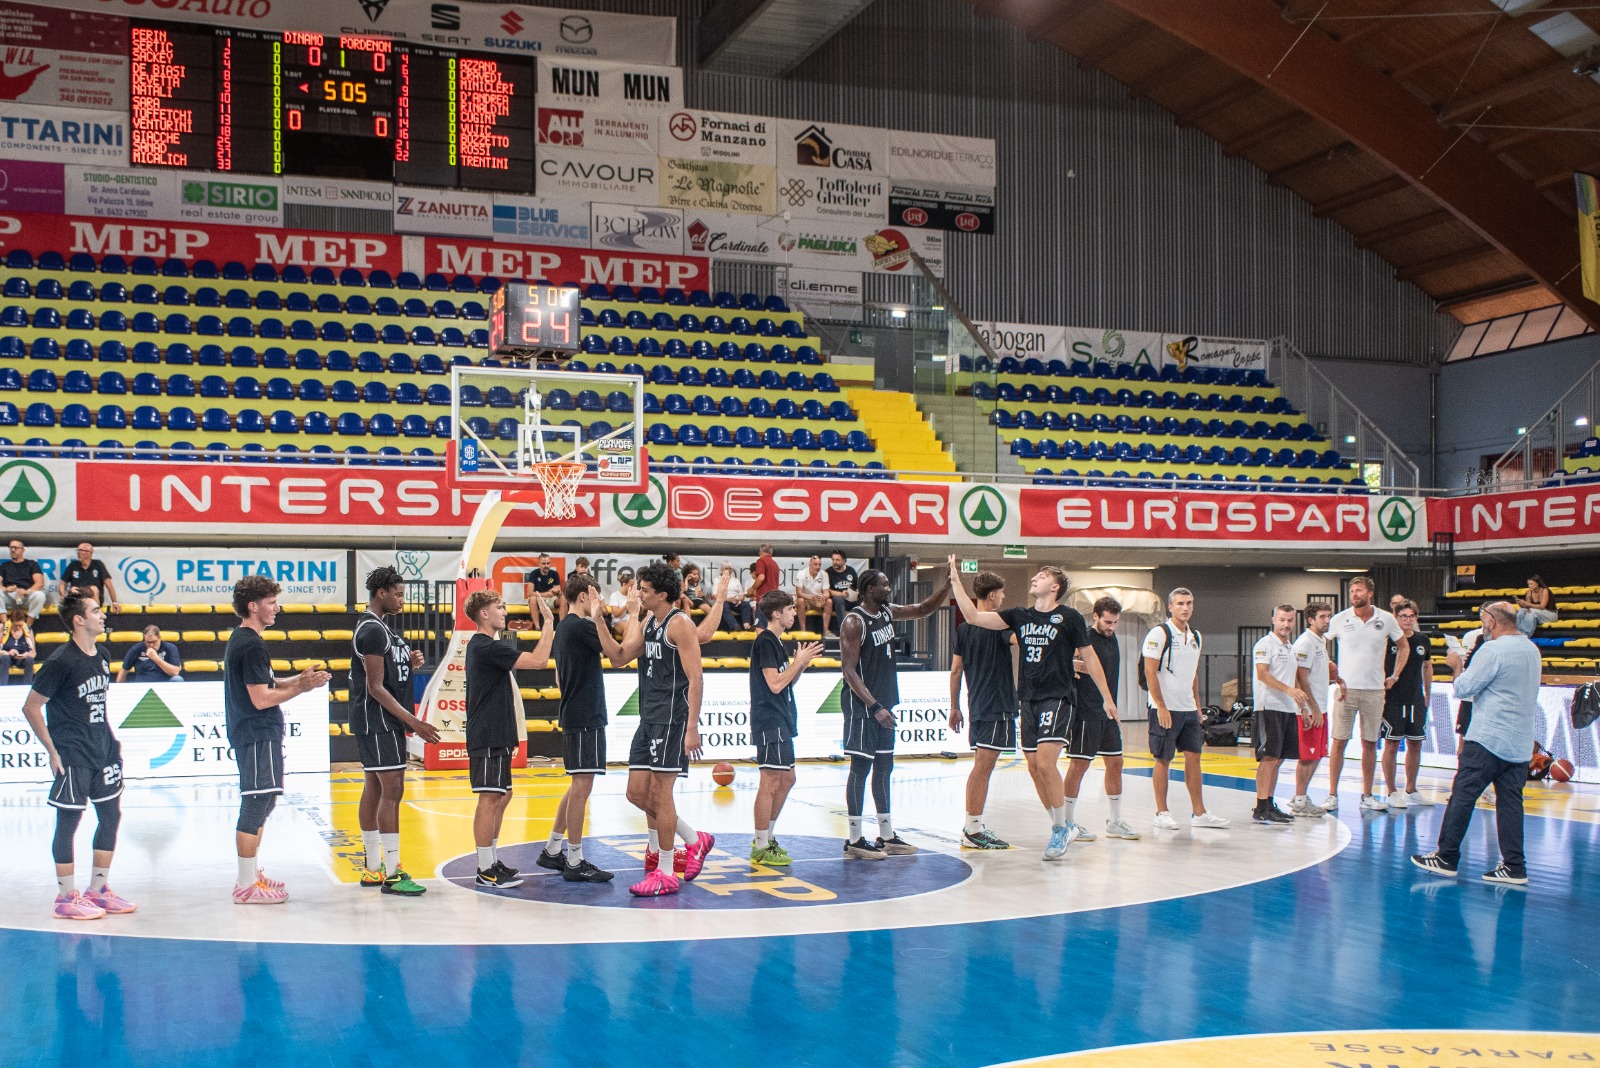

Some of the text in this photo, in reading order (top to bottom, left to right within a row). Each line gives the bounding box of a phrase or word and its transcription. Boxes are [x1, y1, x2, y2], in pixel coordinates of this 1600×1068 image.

[132, 28, 167, 42] PERIN
[215, 29, 231, 37] PLYR
[237, 31, 257, 39] FOULS
[283, 31, 392, 53] DINAMO PORDENON
[421, 34, 471, 46] SEAT
[484, 37, 542, 51] SUZUKI
[132, 39, 173, 53] SERTIC
[415, 48, 434, 56] FOULS
[132, 51, 173, 64] SACKEY
[308, 46, 386, 73] 0 0
[401, 54, 497, 72] 4 AZZANO
[132, 63, 186, 78] DE BIASI
[328, 69, 351, 77] PERIOD
[401, 64, 501, 83] 6 CRAVEDI
[132, 74, 180, 88] DEVETTA
[402, 75, 514, 95] 7 MINICLERI
[552, 67, 670, 102] MUN MUN
[132, 84, 231, 104] NATALI 10
[402, 85, 509, 104] 9 D'ANDREA
[132, 96, 231, 114] SARA 11
[285, 103, 305, 111] FOULS
[372, 110, 392, 118] FOULS
[398, 97, 509, 116] 10 RINALDIN
[133, 107, 231, 125] TOFFETCHI 13
[288, 110, 388, 137] 0 0
[398, 108, 496, 125] 11 CUGINI
[594, 118, 649, 131] SERRAMENTI
[701, 116, 766, 133] Fornaci di
[133, 118, 231, 136] VENTURINI 18
[398, 118, 492, 135] 14 VUJIC
[605, 129, 649, 140] ALLUMINIO
[133, 130, 231, 147] GIACCHE 25
[398, 128, 510, 148] 16 BOZZETTO
[701, 130, 766, 147] Manzano
[71, 147, 97, 155] SINCE
[133, 142, 231, 159] SANAD 27
[395, 139, 490, 156] 21 ROSSI
[133, 152, 231, 170] MICALICH 33
[395, 150, 508, 169] 22 TRENTINI
[540, 159, 654, 184] CAVOUR
[287, 185, 392, 201] INTESA SANPAOLO
[557, 180, 636, 192] IMMOBILIARE
[816, 176, 882, 196] Toffoletti
[210, 186, 274, 209] SIRIO
[181, 208, 278, 225] real estate group
[417, 201, 488, 218] ZANUTTA
[518, 206, 559, 224] BLUE
[852, 209, 862, 217] del
[864, 210, 885, 219] Lavoro
[518, 222, 589, 240] SERVICE
[708, 232, 770, 254] Cardinale
[69, 220, 699, 289] MEP MEP MEP MEP
[521, 307, 570, 344] 24
[462, 459, 477, 467] FIP
[610, 456, 632, 465] LNP
[671, 485, 944, 526] DESPAR
[1056, 497, 1367, 534] EUROSPAR
[176, 559, 337, 582] PETTARINI
[177, 585, 213, 593] ITALIAN
[287, 586, 314, 594] SINCE
[317, 586, 337, 594] 1957
[871, 623, 895, 647] DINAMO
[1020, 623, 1059, 641] DINAMO
[1024, 636, 1050, 646] GORIZIA
[1026, 646, 1043, 663] 33
[397, 664, 410, 682] 13
[77, 674, 110, 699] DINAM
[1039, 711, 1054, 727] 33
[103, 763, 122, 786] 25
